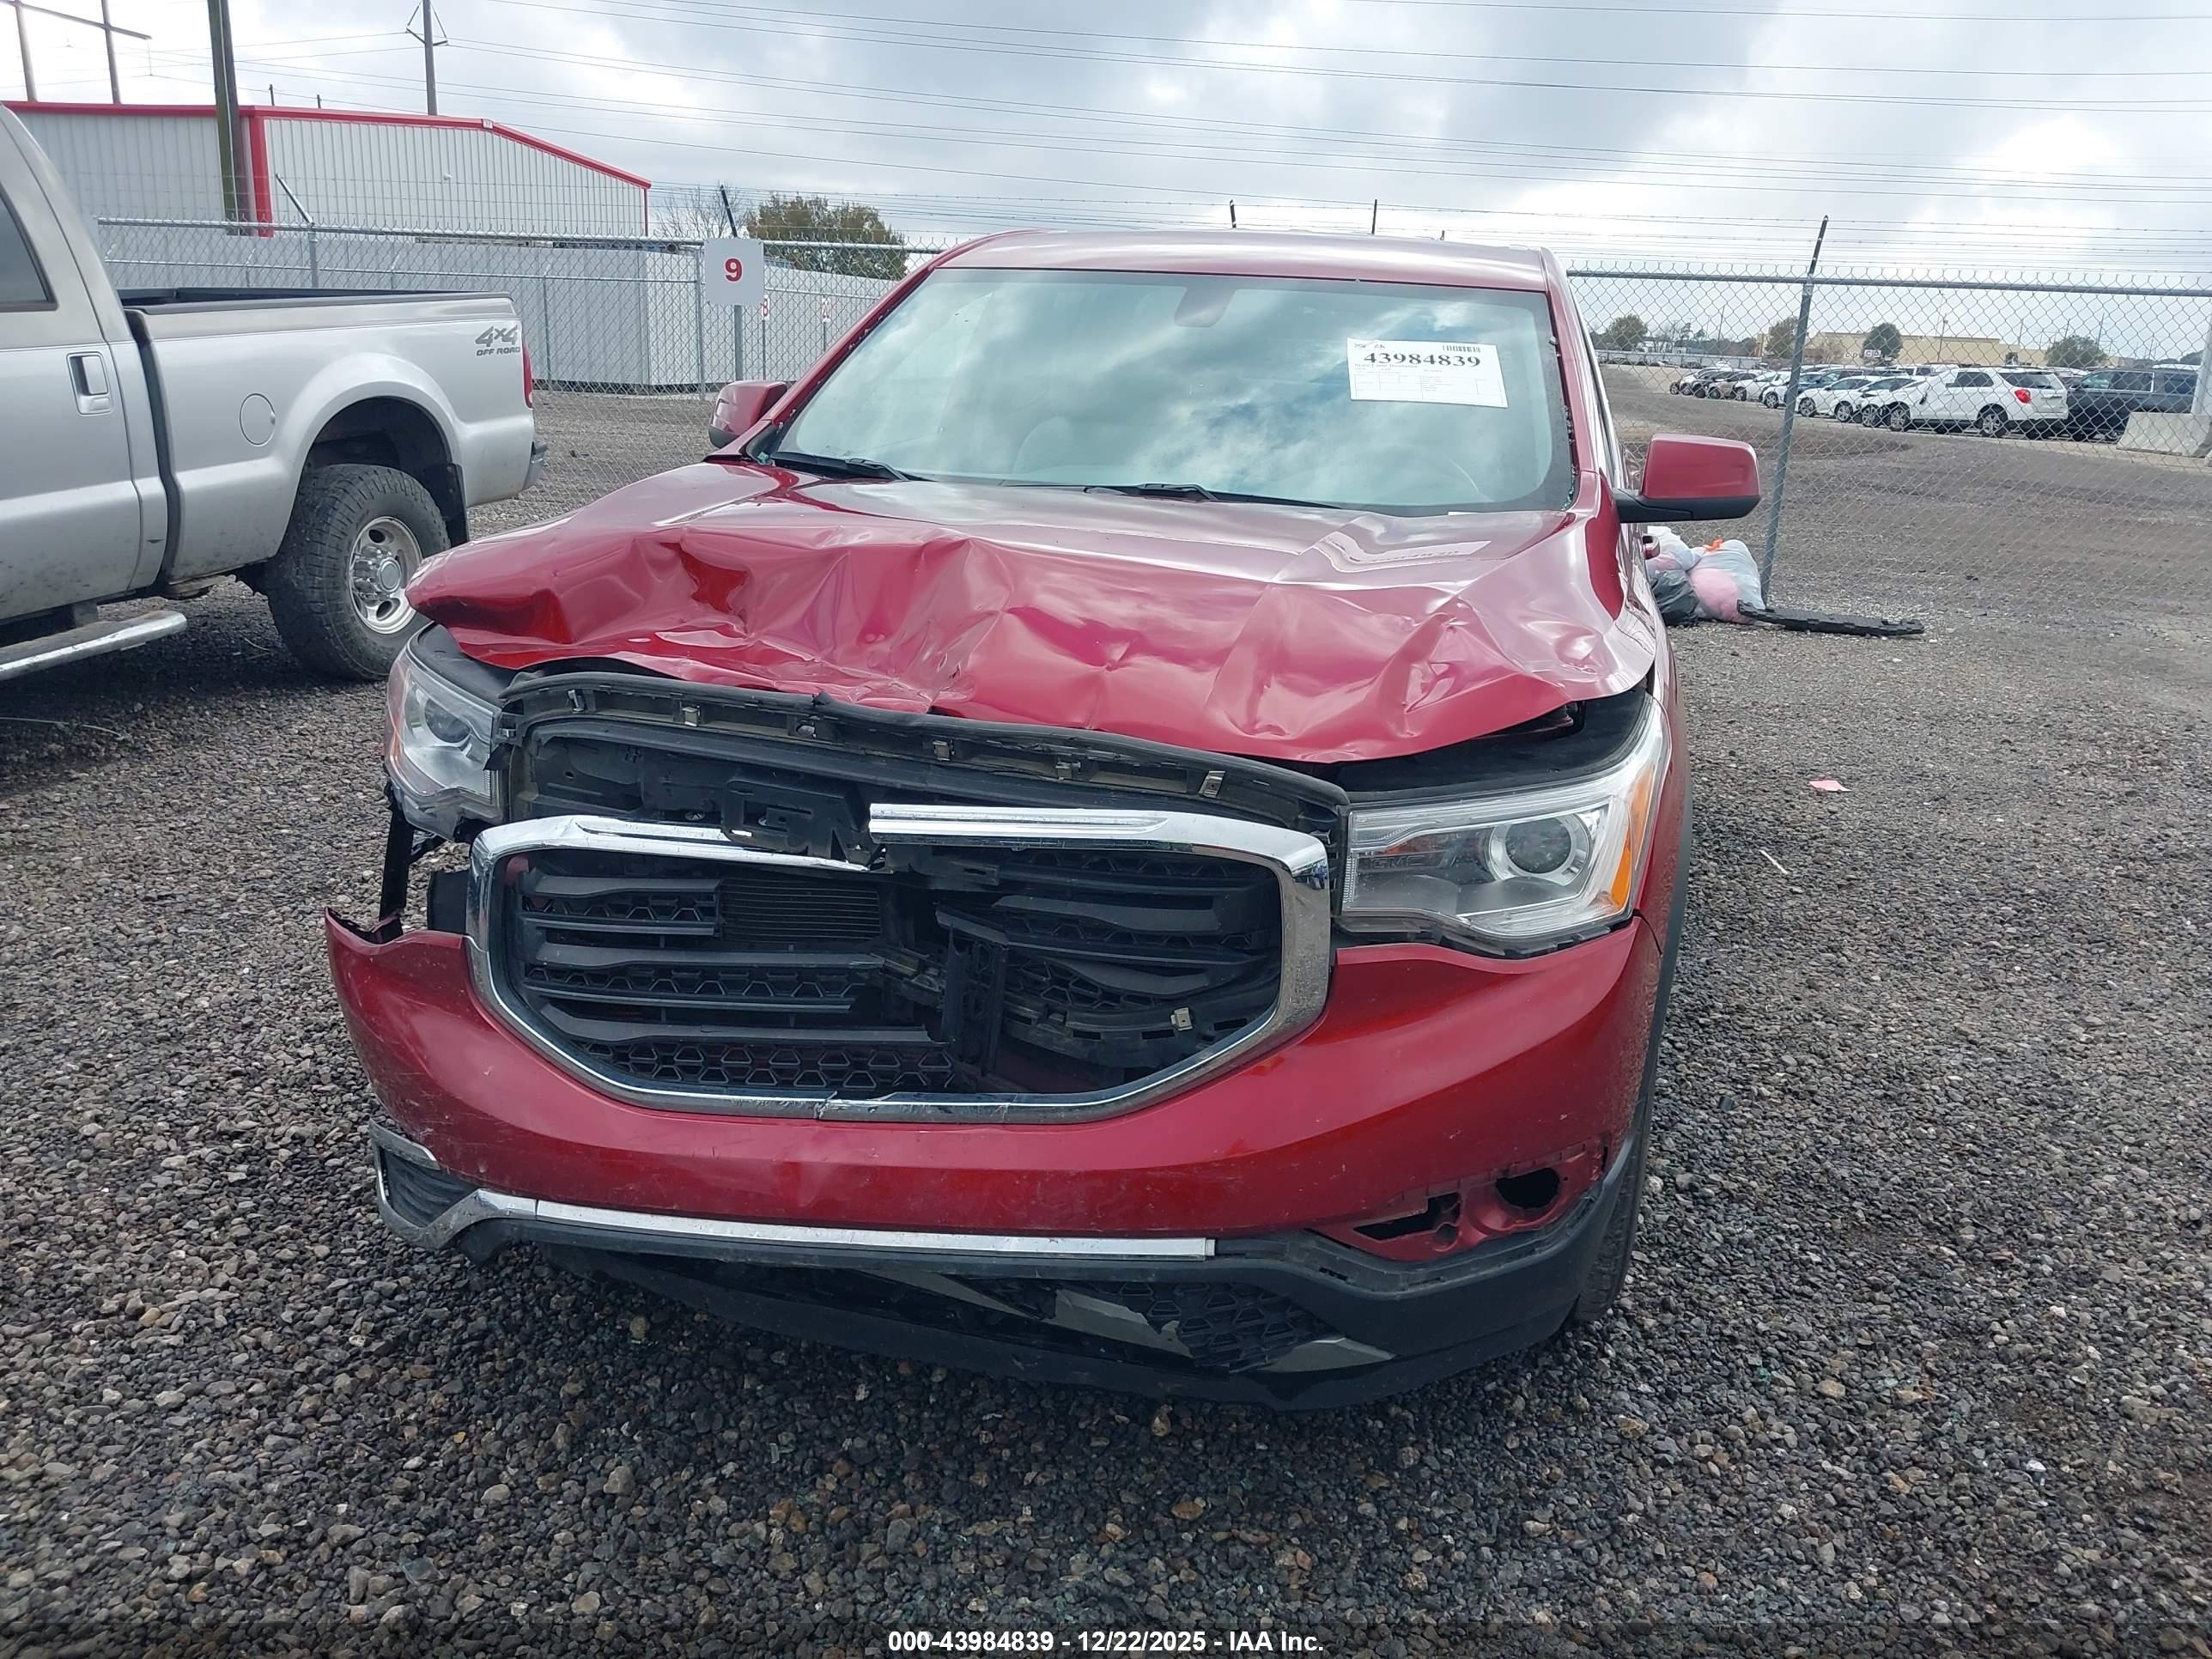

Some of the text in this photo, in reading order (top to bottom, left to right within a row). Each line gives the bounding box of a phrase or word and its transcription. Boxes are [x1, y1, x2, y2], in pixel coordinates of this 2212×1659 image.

[725, 258, 743, 283] 9
[477, 346, 520, 356] OFF ROAD
[1364, 352, 1480, 368] 43984839
[1371, 854, 1425, 869] GMC
